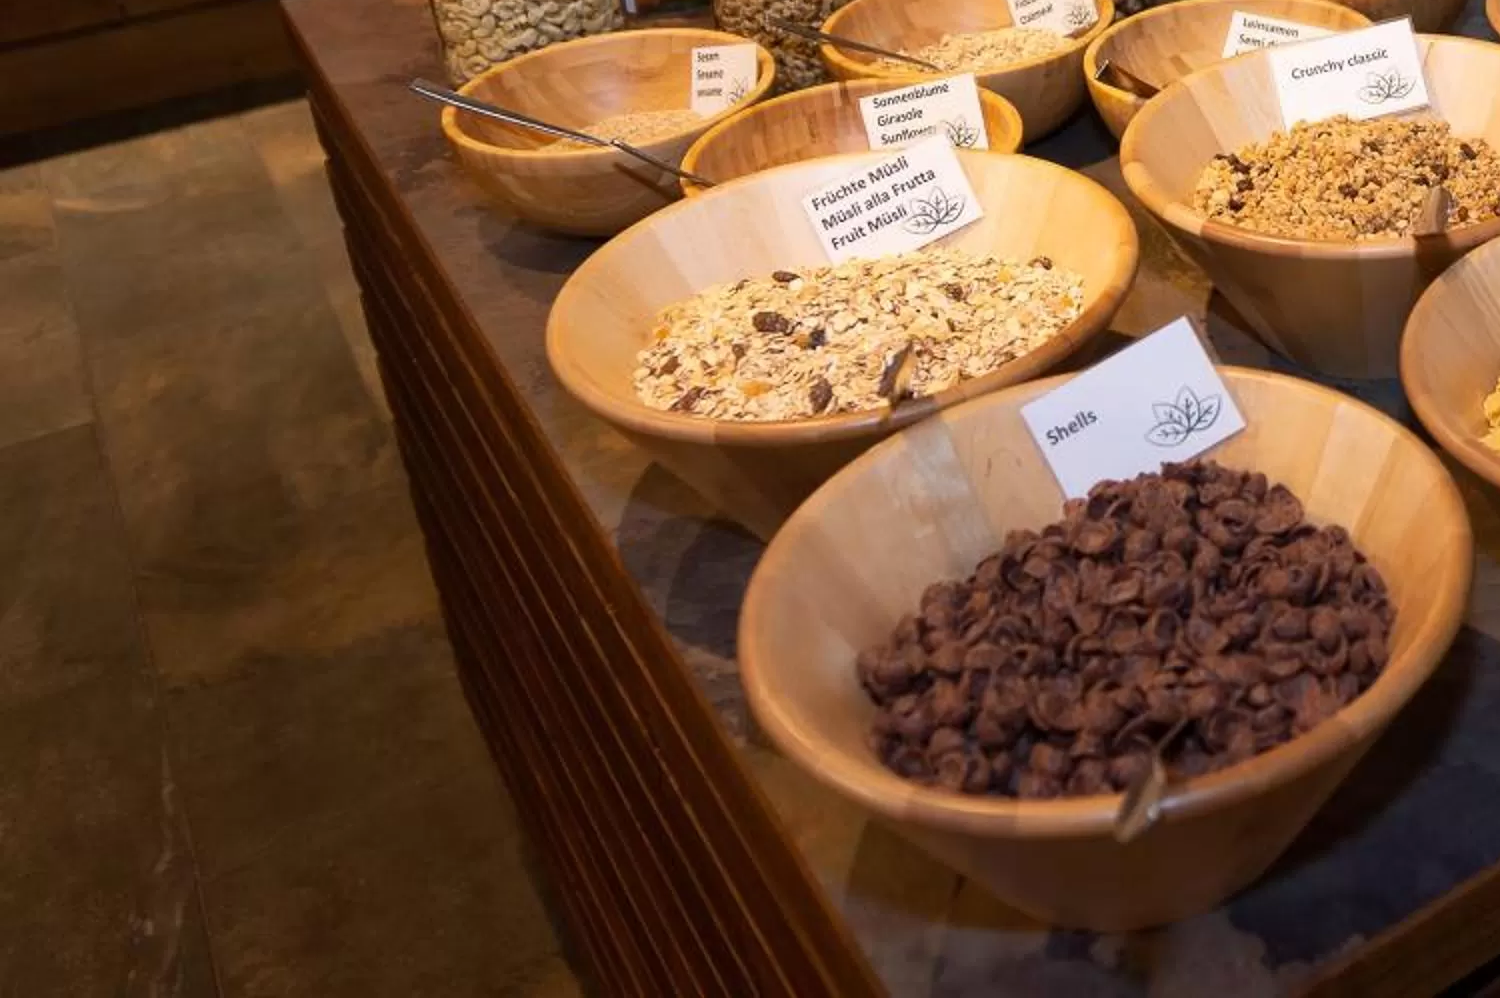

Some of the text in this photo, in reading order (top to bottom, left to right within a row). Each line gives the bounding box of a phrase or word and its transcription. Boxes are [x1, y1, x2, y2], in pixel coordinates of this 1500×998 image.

[1291, 48, 1388, 80] Crunchy classic
[872, 83, 949, 109] Sonnenblume
[877, 107, 923, 126] Girasole
[811, 156, 910, 211] Früchte Müsli
[821, 169, 937, 231] Müsli alla Frutta
[831, 206, 908, 250] Fruit Müsli
[1046, 409, 1098, 445] Shells
